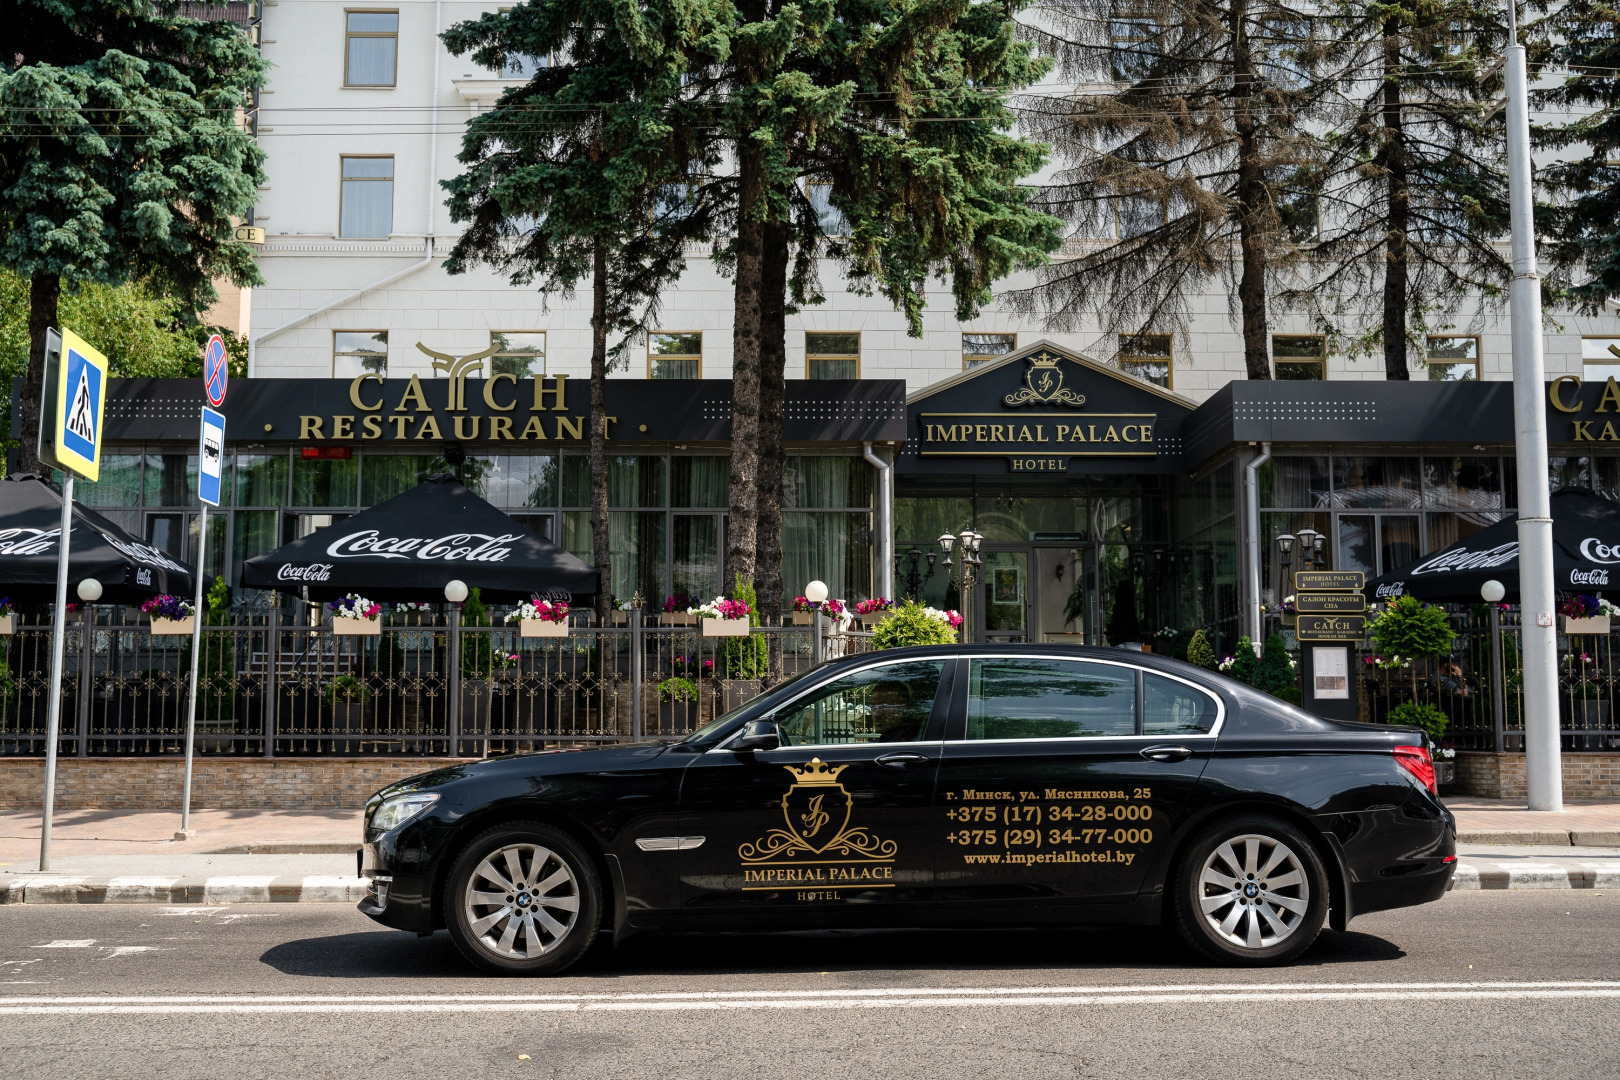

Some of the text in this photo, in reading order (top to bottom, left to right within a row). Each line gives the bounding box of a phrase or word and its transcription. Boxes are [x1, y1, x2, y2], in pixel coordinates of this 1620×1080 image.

[349, 341, 570, 412] CATCH
[1549, 375, 1620, 412] CA
[926, 424, 1153, 443] IMPERIAL PALACE
[1012, 459, 1067, 470] HOTEL
[326, 529, 525, 562] Coca-Cola
[277, 563, 334, 581] Coca-Cola
[1571, 568, 1609, 585] Coca-Cola
[1314, 617, 1350, 630] CATCH
[946, 788, 1151, 802] г. Минск, ул. Мясникова, 25
[947, 805, 1153, 826] +375 (17) 34-28-000
[947, 829, 1153, 849] +375 (29) 34-77-000
[964, 850, 1135, 866] www.imperialhotel.by
[744, 867, 893, 882] IMPERIAL PALACE
[797, 891, 841, 901] HOTEL
